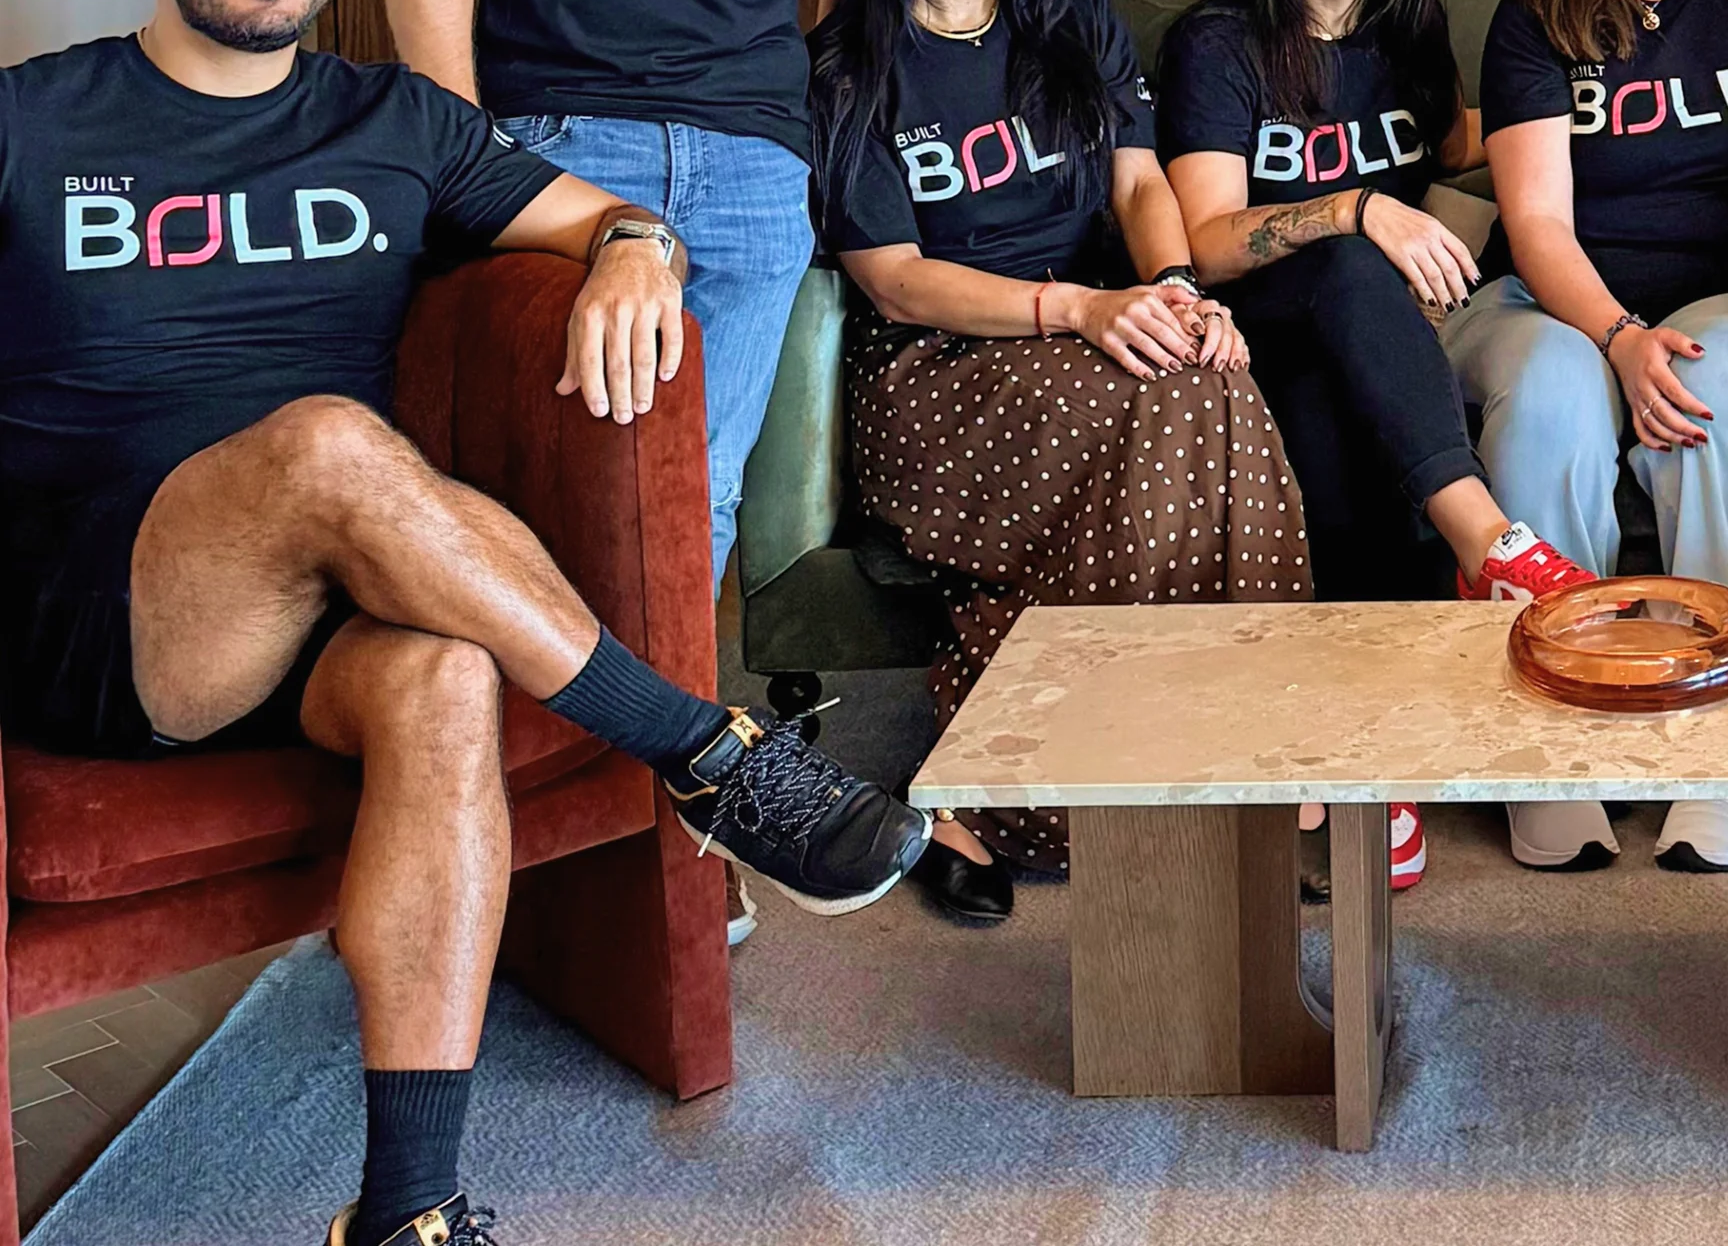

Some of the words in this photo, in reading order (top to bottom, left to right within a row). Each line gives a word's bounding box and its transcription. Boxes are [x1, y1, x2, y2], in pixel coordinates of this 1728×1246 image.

[894, 122, 942, 148] BUILT
[1252, 109, 1431, 183] BOLD
[64, 176, 135, 192] BUILT
[65, 187, 389, 272] BOLD.
